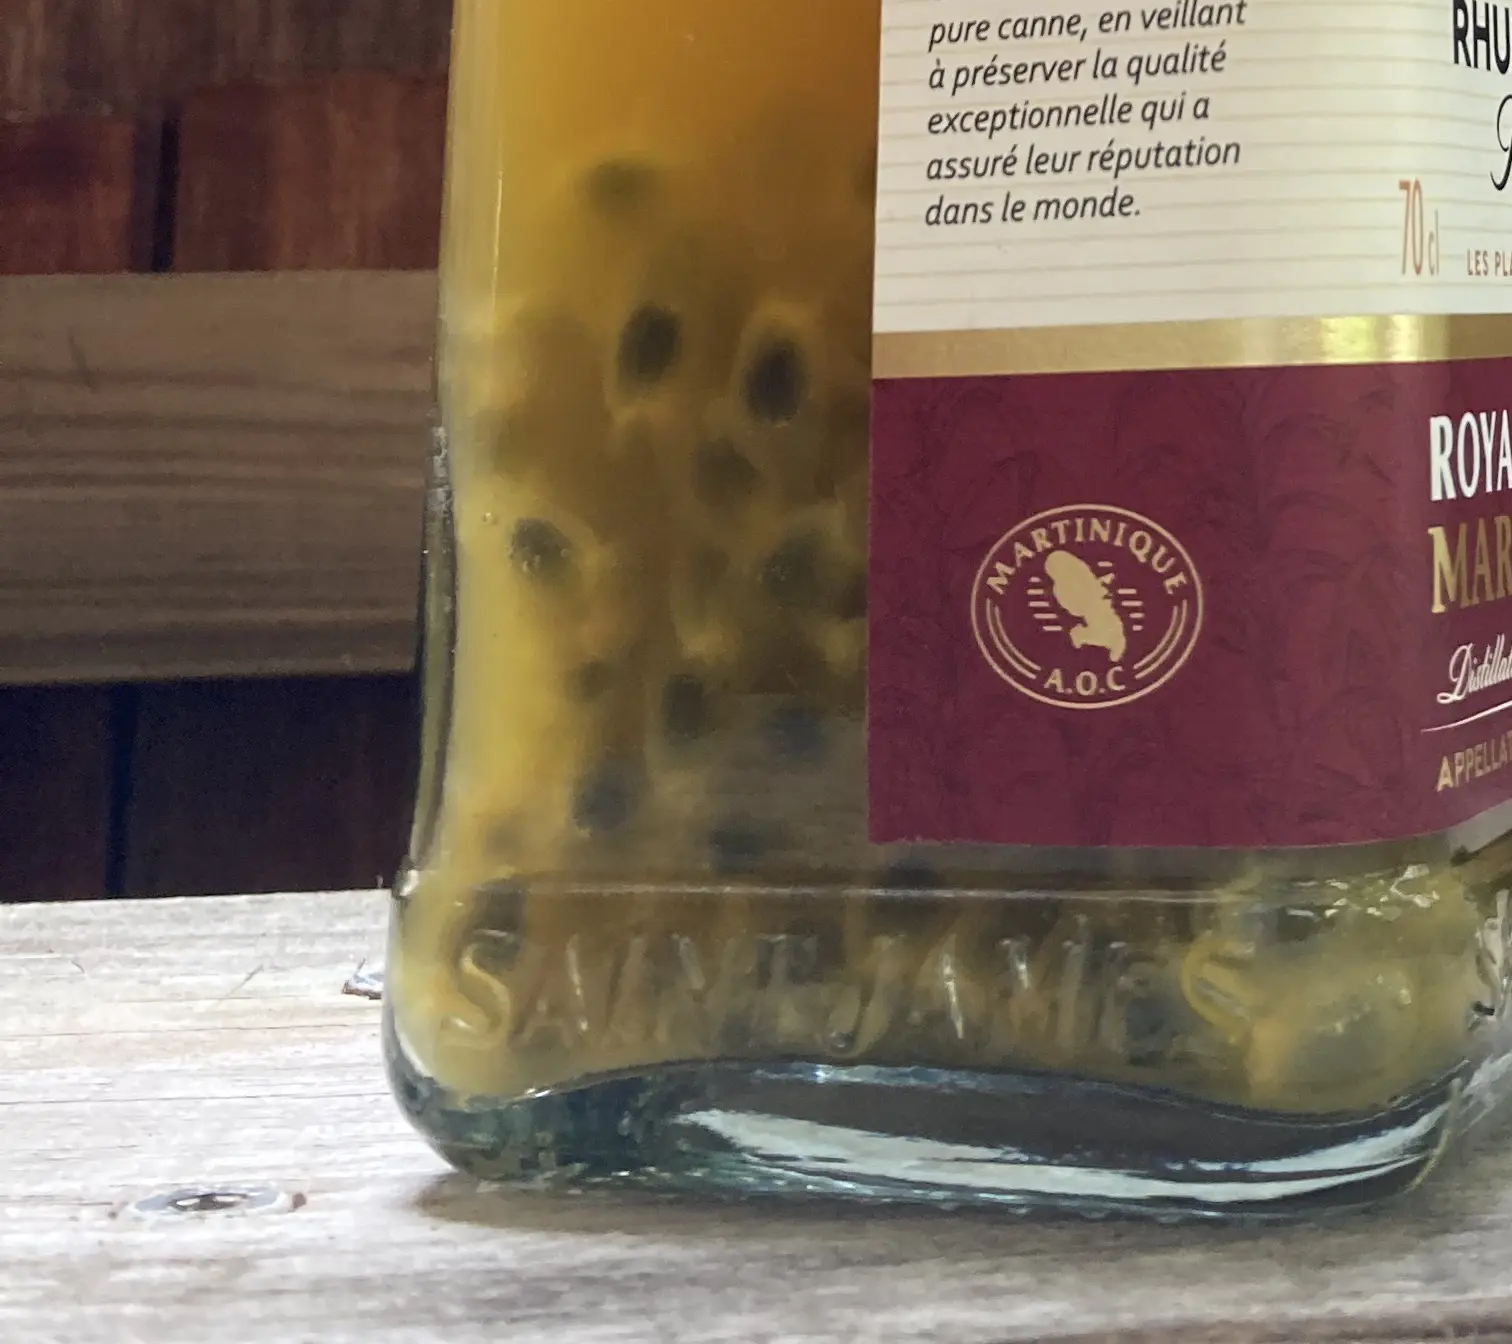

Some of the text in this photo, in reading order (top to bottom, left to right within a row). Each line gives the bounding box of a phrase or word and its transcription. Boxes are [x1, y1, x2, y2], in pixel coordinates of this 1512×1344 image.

[928, 17, 990, 53] pure
[997, 12, 1087, 41] canne,
[1098, 8, 1131, 33] en
[929, 39, 1227, 97] à préserver la qualité
[928, 91, 1210, 139] exceptionnelle qui a
[926, 137, 1241, 180] assuré leur réputation
[925, 186, 1141, 226] dans le monde.
[1399, 178, 1424, 276] 70
[1467, 249, 1489, 276] LES
[985, 517, 1188, 596] MARTINIQUE
[1044, 666, 1126, 696] A.O.C
